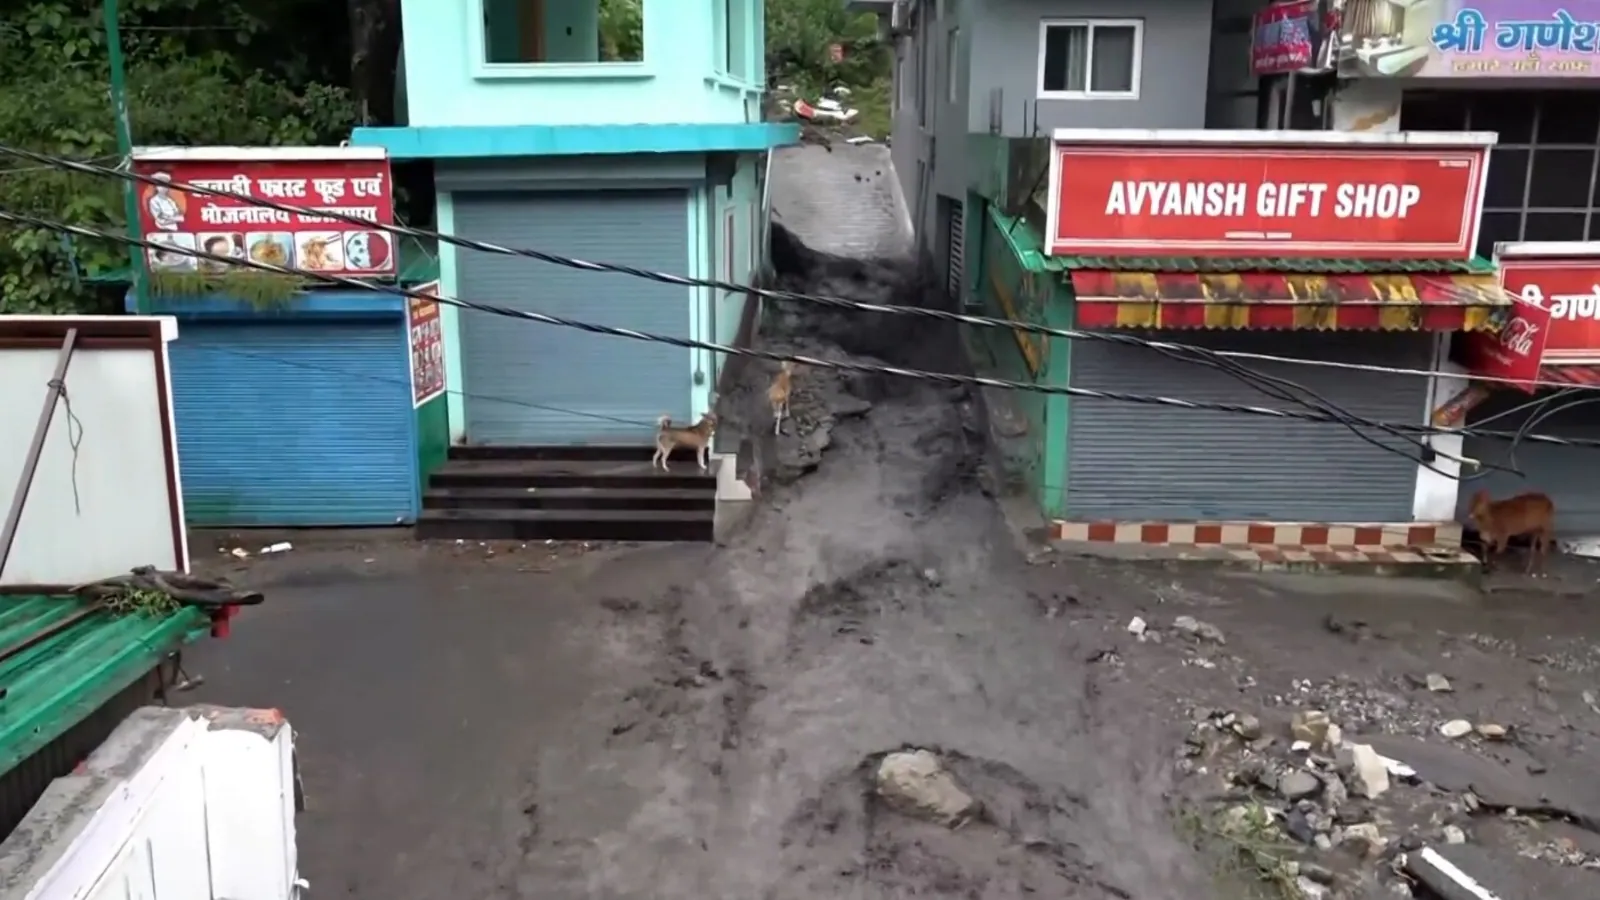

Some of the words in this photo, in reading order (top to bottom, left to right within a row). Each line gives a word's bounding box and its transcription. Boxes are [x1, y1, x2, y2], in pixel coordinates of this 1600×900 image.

[1428, 8, 1488, 52] श्री
[351, 172, 383, 196] एवं
[1105, 181, 1247, 217] AVYANSH
[1256, 183, 1328, 218] GIFT
[1334, 183, 1421, 219] SHOP
